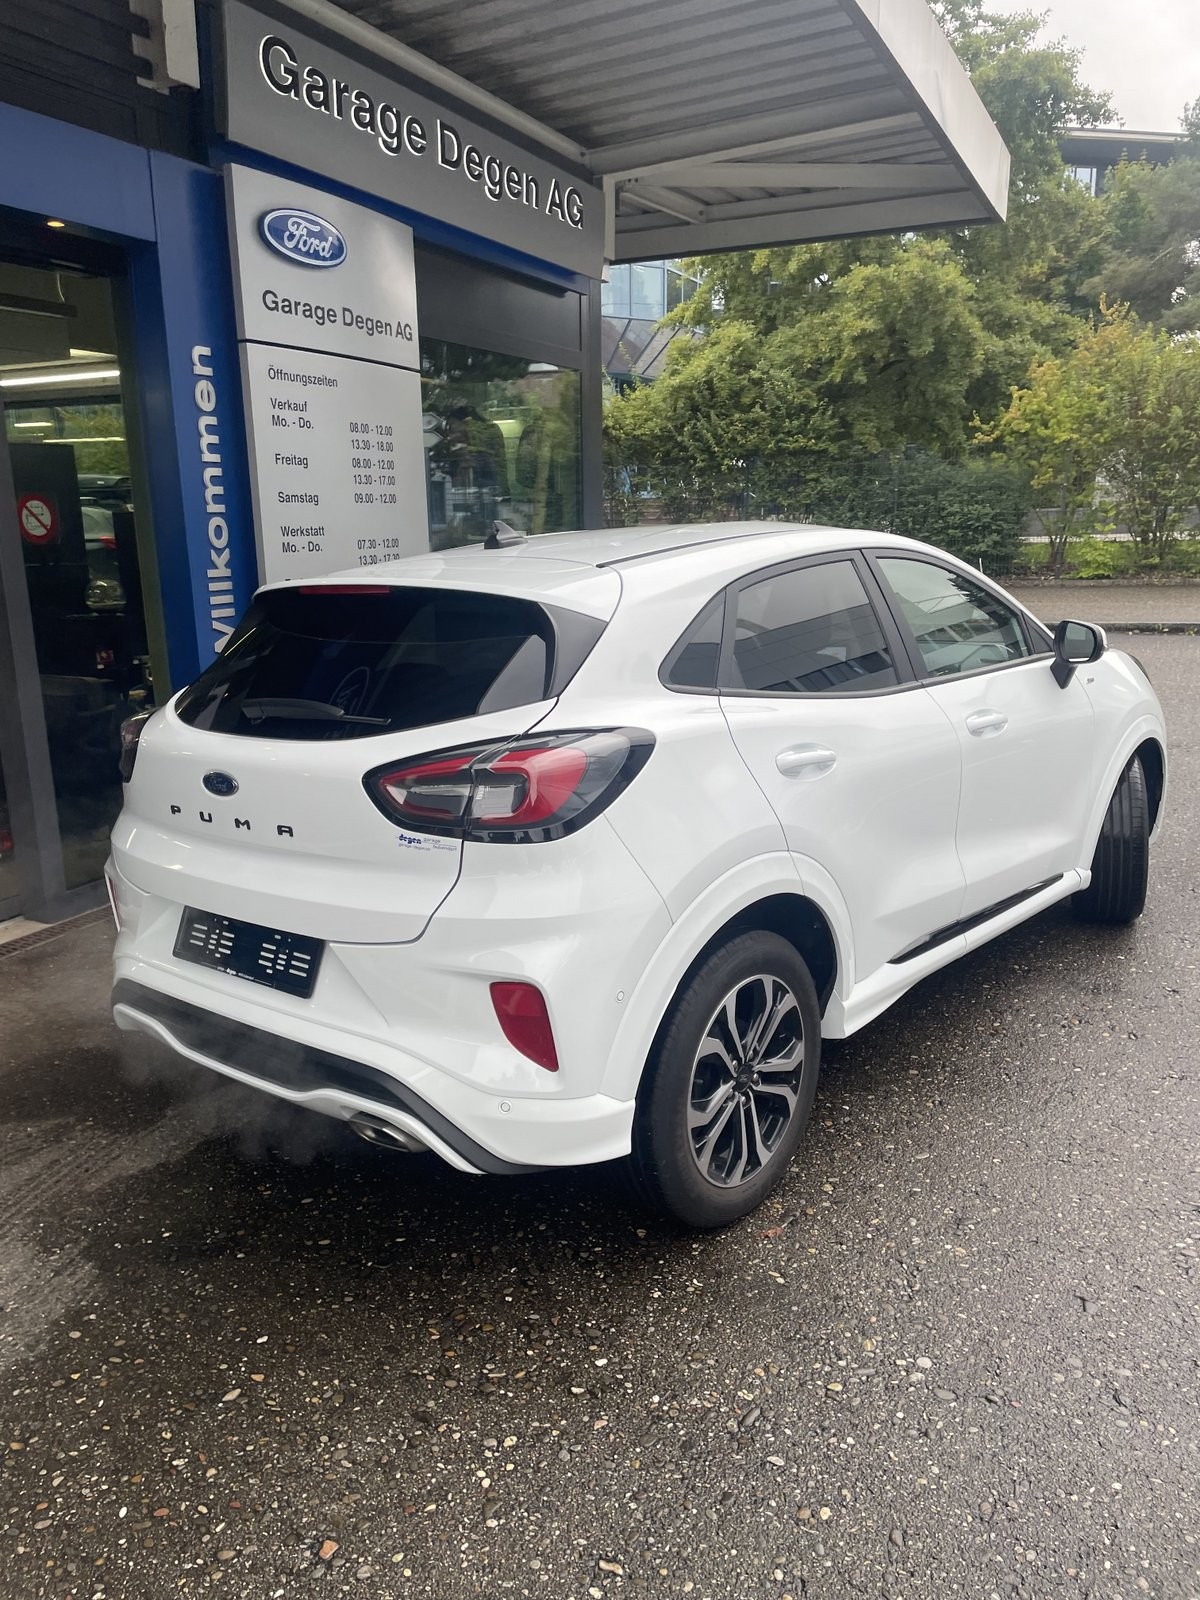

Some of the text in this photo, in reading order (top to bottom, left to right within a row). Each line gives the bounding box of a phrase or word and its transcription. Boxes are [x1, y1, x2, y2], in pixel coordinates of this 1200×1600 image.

[259, 34, 584, 229] Garage Degen AG
[262, 290, 414, 342] Garage Degen AG
[268, 365, 338, 388] Öffnungszeiten
[270, 398, 308, 413] Verkauf
[272, 415, 290, 428] Mo.
[299, 417, 314, 430] Do.
[350, 422, 370, 435] 08.00
[376, 425, 393, 437] 12.00
[352, 439, 371, 451] 13.30
[377, 441, 394, 453] 18.00
[275, 454, 309, 469] Freitag
[352, 458, 372, 470] 08.00
[378, 460, 395, 471] 12.00
[354, 475, 373, 486] 13.30
[379, 476, 396, 486] 17.00
[278, 492, 319, 507] Samstag
[355, 493, 374, 504] 09.00
[380, 494, 397, 504] 12.00
[281, 526, 325, 538] Werkstatt
[282, 542, 300, 553] Mo.
[308, 541, 323, 553] Do.
[358, 540, 377, 550] 07.30
[383, 538, 400, 549] 12.00
[359, 555, 378, 566] 13.30
[170, 804, 294, 837] PUMA
